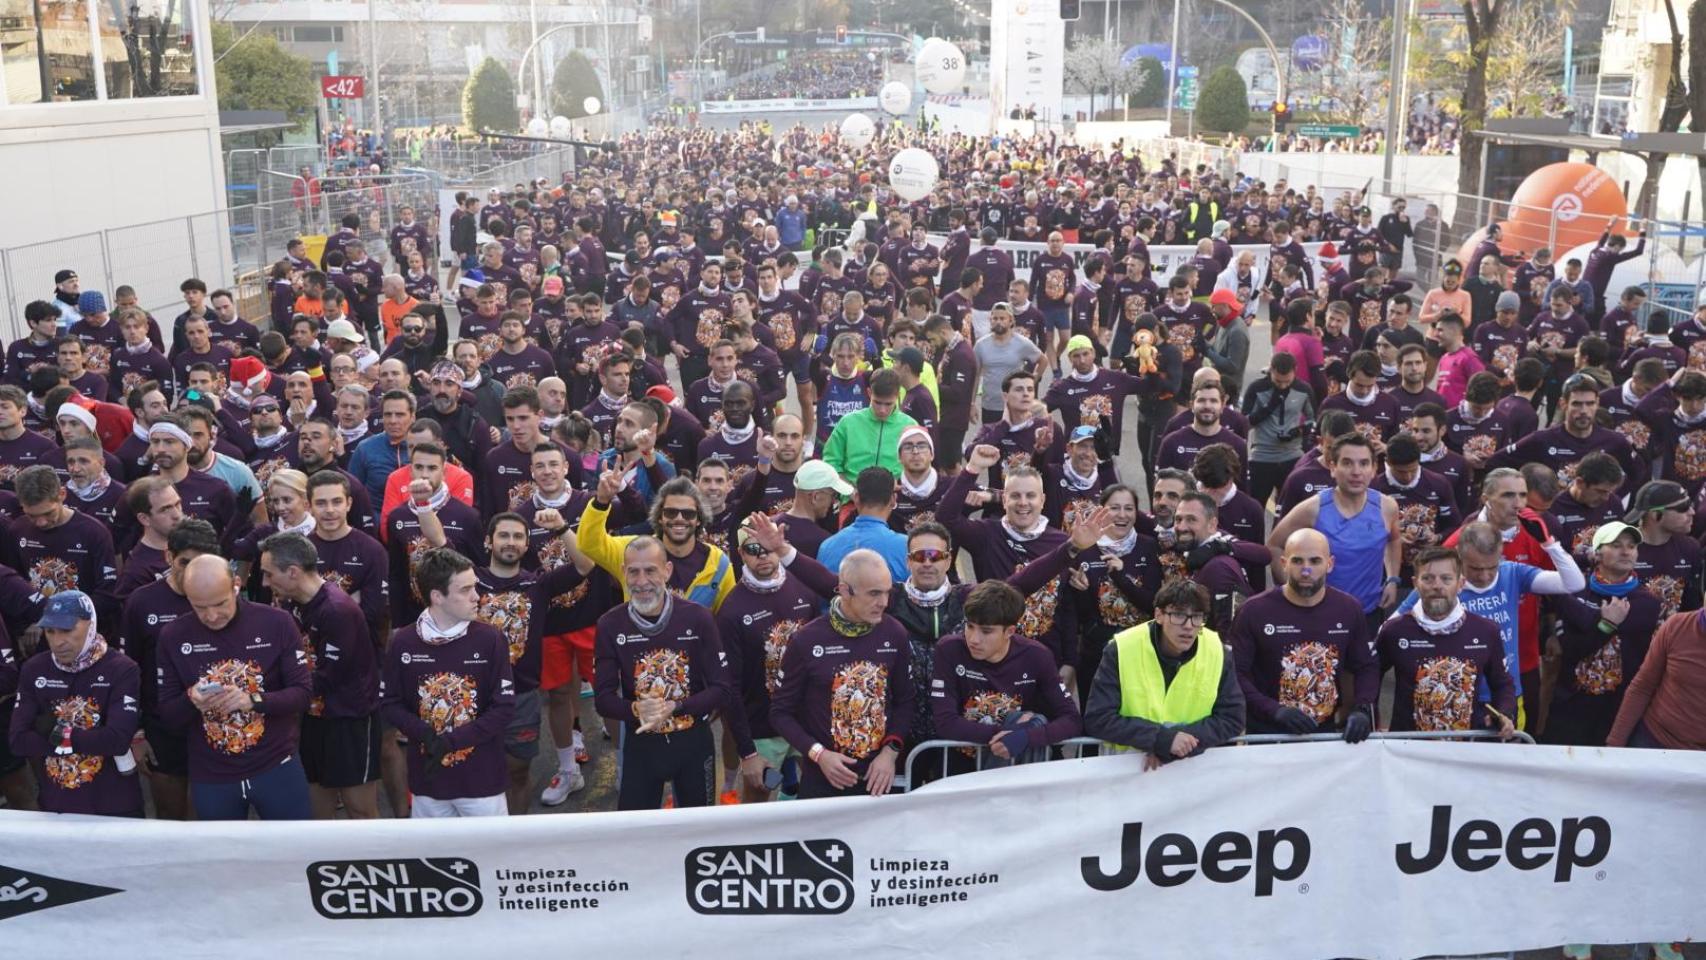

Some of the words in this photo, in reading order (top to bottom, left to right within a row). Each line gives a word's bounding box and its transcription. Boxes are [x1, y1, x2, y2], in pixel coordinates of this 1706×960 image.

[1460, 591, 1508, 612] ARRERA
[1394, 805, 1612, 883] Jeep
[696, 848, 784, 876] SANI
[870, 858, 949, 874] Limpieza
[1080, 822, 1311, 897] Jeep
[317, 863, 410, 888] SANI
[496, 868, 577, 882] Limpieza
[871, 879, 880, 893] y
[887, 872, 999, 890] desinfección
[498, 885, 508, 897] y
[515, 880, 629, 894] desinfección
[694, 878, 848, 909] CENTRO
[320, 887, 475, 914] CENTRO
[499, 897, 599, 912] inteligente
[870, 891, 968, 908] inteligente
